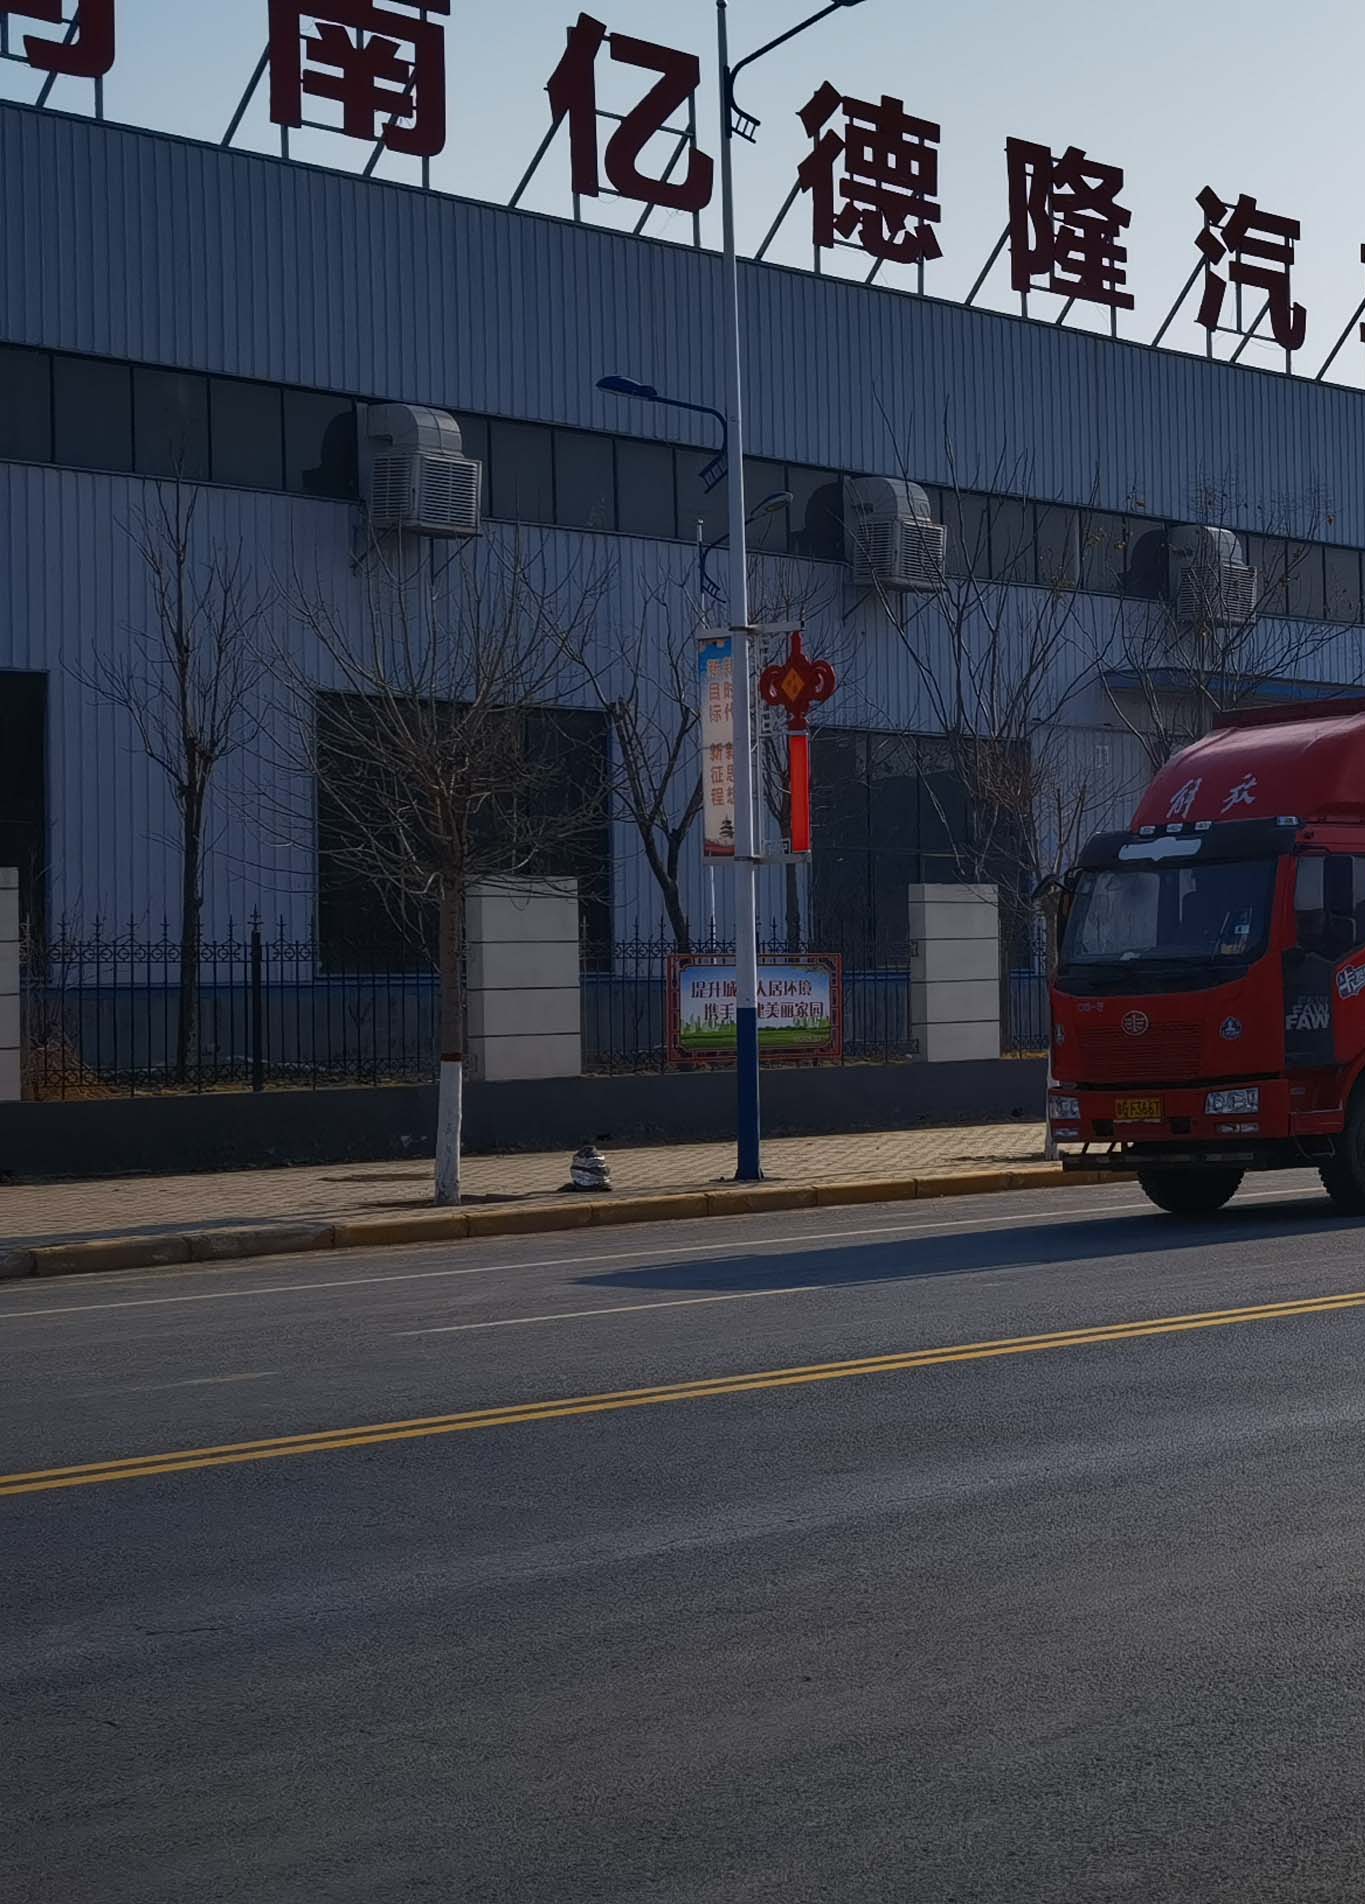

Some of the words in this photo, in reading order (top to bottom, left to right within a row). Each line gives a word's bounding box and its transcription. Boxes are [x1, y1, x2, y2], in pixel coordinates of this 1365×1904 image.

[691, 980, 812, 998] 提升城人居环境
[1285, 1014, 1331, 1030] FAW
